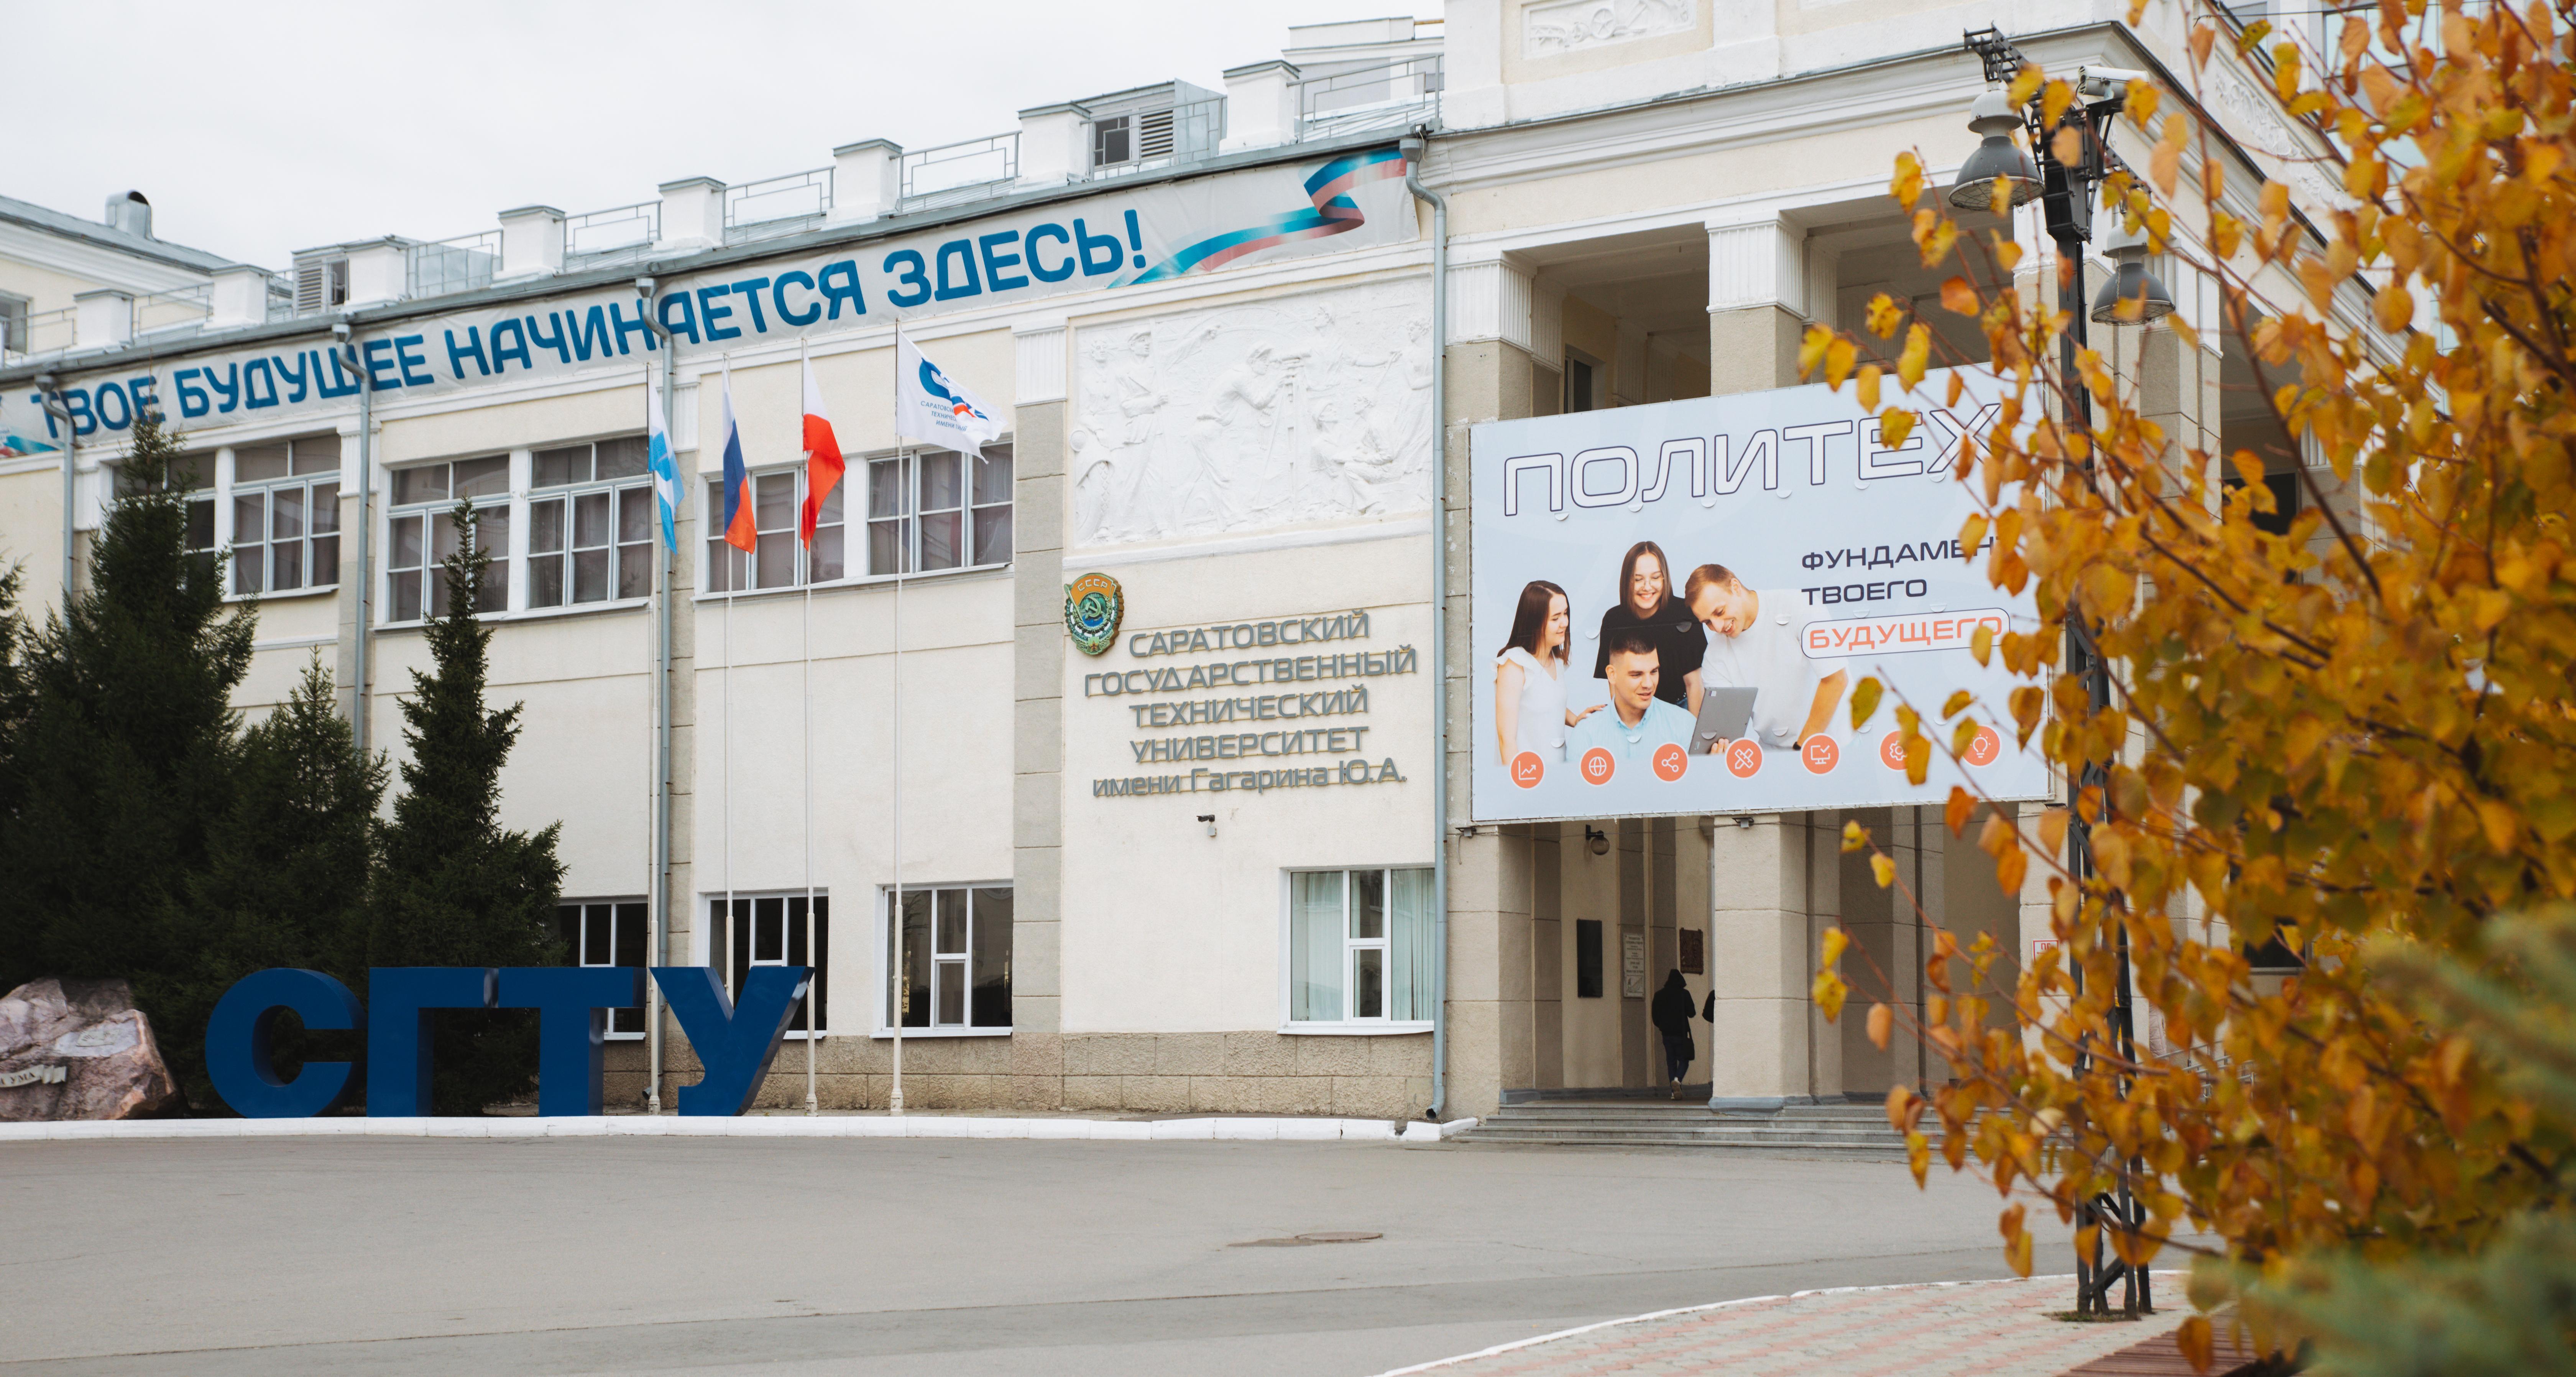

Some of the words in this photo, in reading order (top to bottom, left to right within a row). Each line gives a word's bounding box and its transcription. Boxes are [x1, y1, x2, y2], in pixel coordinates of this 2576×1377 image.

[30, 375, 166, 438] ТВОЕ
[173, 334, 434, 418] БУДУЩЕЕ
[444, 260, 867, 380] НАЧИНАЕТСЯ
[883, 209, 1147, 307] ЗДЕСЬ!
[936, 420, 955, 428] ИМЕНИ
[1504, 403, 2002, 517] ПОЛИТЕХ
[1802, 536, 1999, 570] ФУНДАМЕН
[1077, 578, 1108, 591] СССР
[1802, 579, 1927, 605] ТВОЕГО
[1129, 608, 1369, 657] САРАТОВСКИЙ
[1810, 617, 2002, 651] БУДУЩЕГО
[1084, 644, 1417, 697] ГОСУДАРСТВЕННЫЙ
[1129, 684, 1369, 728] ТЕХНИЧЕСКИЙ
[1129, 726, 1369, 763] УНИВЕРСИТЕТ
[1092, 775, 1181, 797] имени
[1190, 767, 1329, 794] Гагарина
[1338, 757, 1408, 785] Ю.А.
[205, 966, 815, 1119] СГТУ
[10, 1072, 36, 1085] УМА
